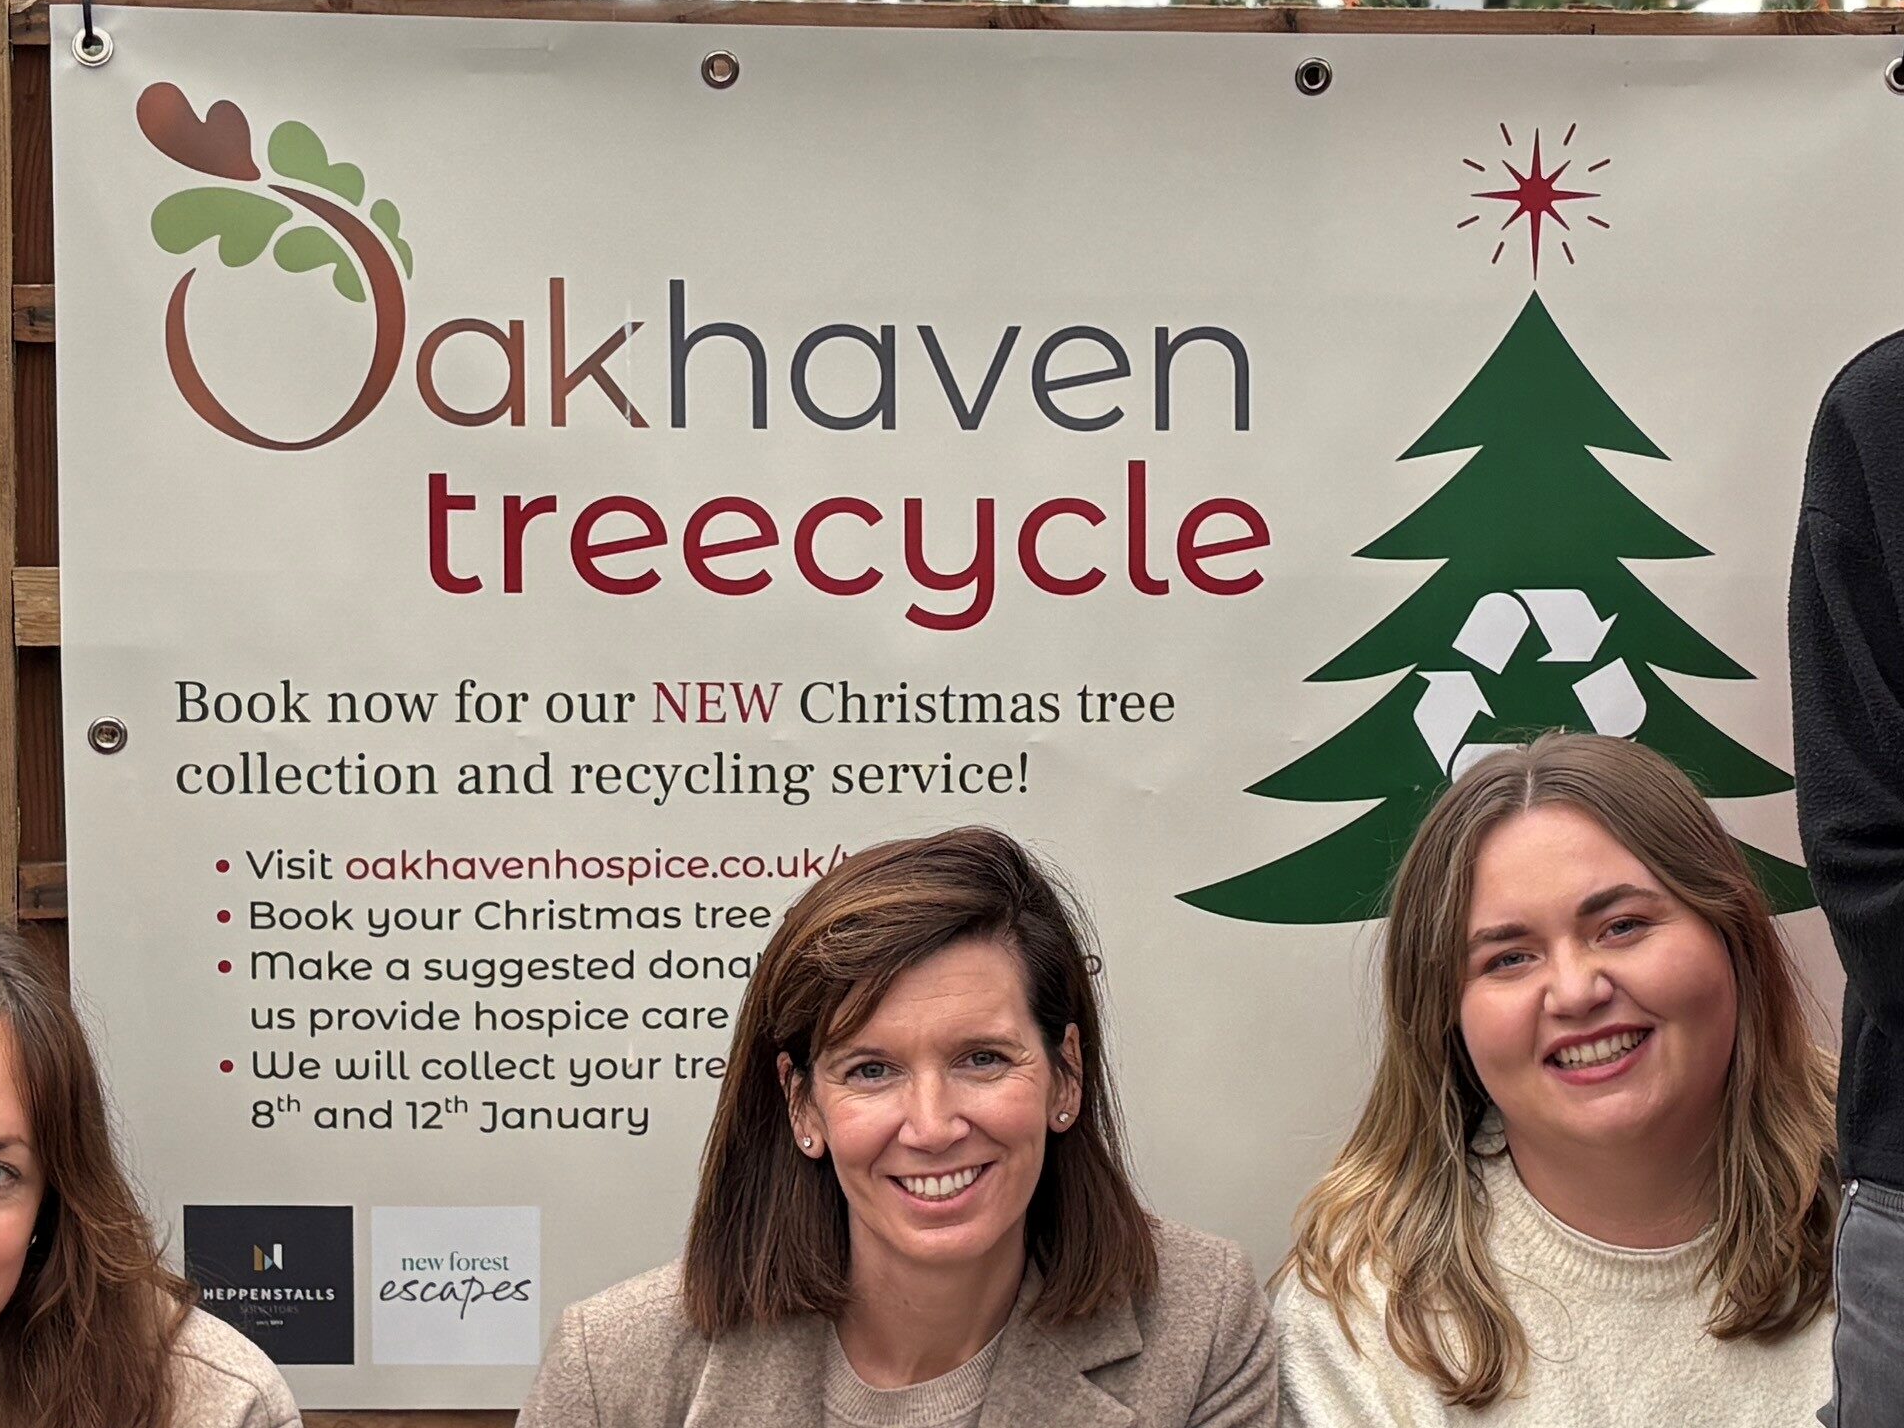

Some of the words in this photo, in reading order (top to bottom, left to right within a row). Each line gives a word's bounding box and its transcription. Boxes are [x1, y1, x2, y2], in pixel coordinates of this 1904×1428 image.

[165, 183, 1252, 451] Oakhaven
[428, 460, 1270, 631] treecycle
[174, 679, 311, 724] Book
[327, 691, 439, 724] now
[455, 679, 529, 724] for
[546, 691, 635, 724] our
[652, 681, 783, 724] NEW
[800, 680, 1060, 724] Christmas
[1077, 683, 1174, 724] tree
[176, 751, 438, 796] collection
[458, 751, 554, 796] and
[571, 751, 814, 807] recycling
[832, 751, 1031, 796] service!
[246, 849, 333, 881] Visit
[345, 843, 853, 885] oakhavenhospice.co.uk/
[250, 899, 354, 931] Book
[368, 907, 461, 939] your
[475, 898, 681, 931] Christmas
[695, 902, 771, 930] tree
[251, 950, 372, 982] Make
[386, 959, 409, 982] a
[424, 949, 634, 988] suggested
[251, 1007, 295, 1031] us
[310, 999, 460, 1039] provide
[475, 999, 629, 1039] hospice
[642, 1006, 729, 1031] care
[253, 1051, 321, 1080] We
[336, 1050, 410, 1080] will
[422, 1050, 555, 1080] collect
[570, 1057, 661, 1088] your
[675, 1053, 727, 1080] tre
[251, 1094, 300, 1130] 8th
[314, 1099, 393, 1130] and
[406, 1094, 468, 1130] 12th
[480, 1102, 649, 1137] January
[401, 1257, 445, 1272] new
[450, 1250, 510, 1272] forest
[202, 1287, 336, 1301] HEPPENSTALLS
[379, 1275, 532, 1320] escapes
